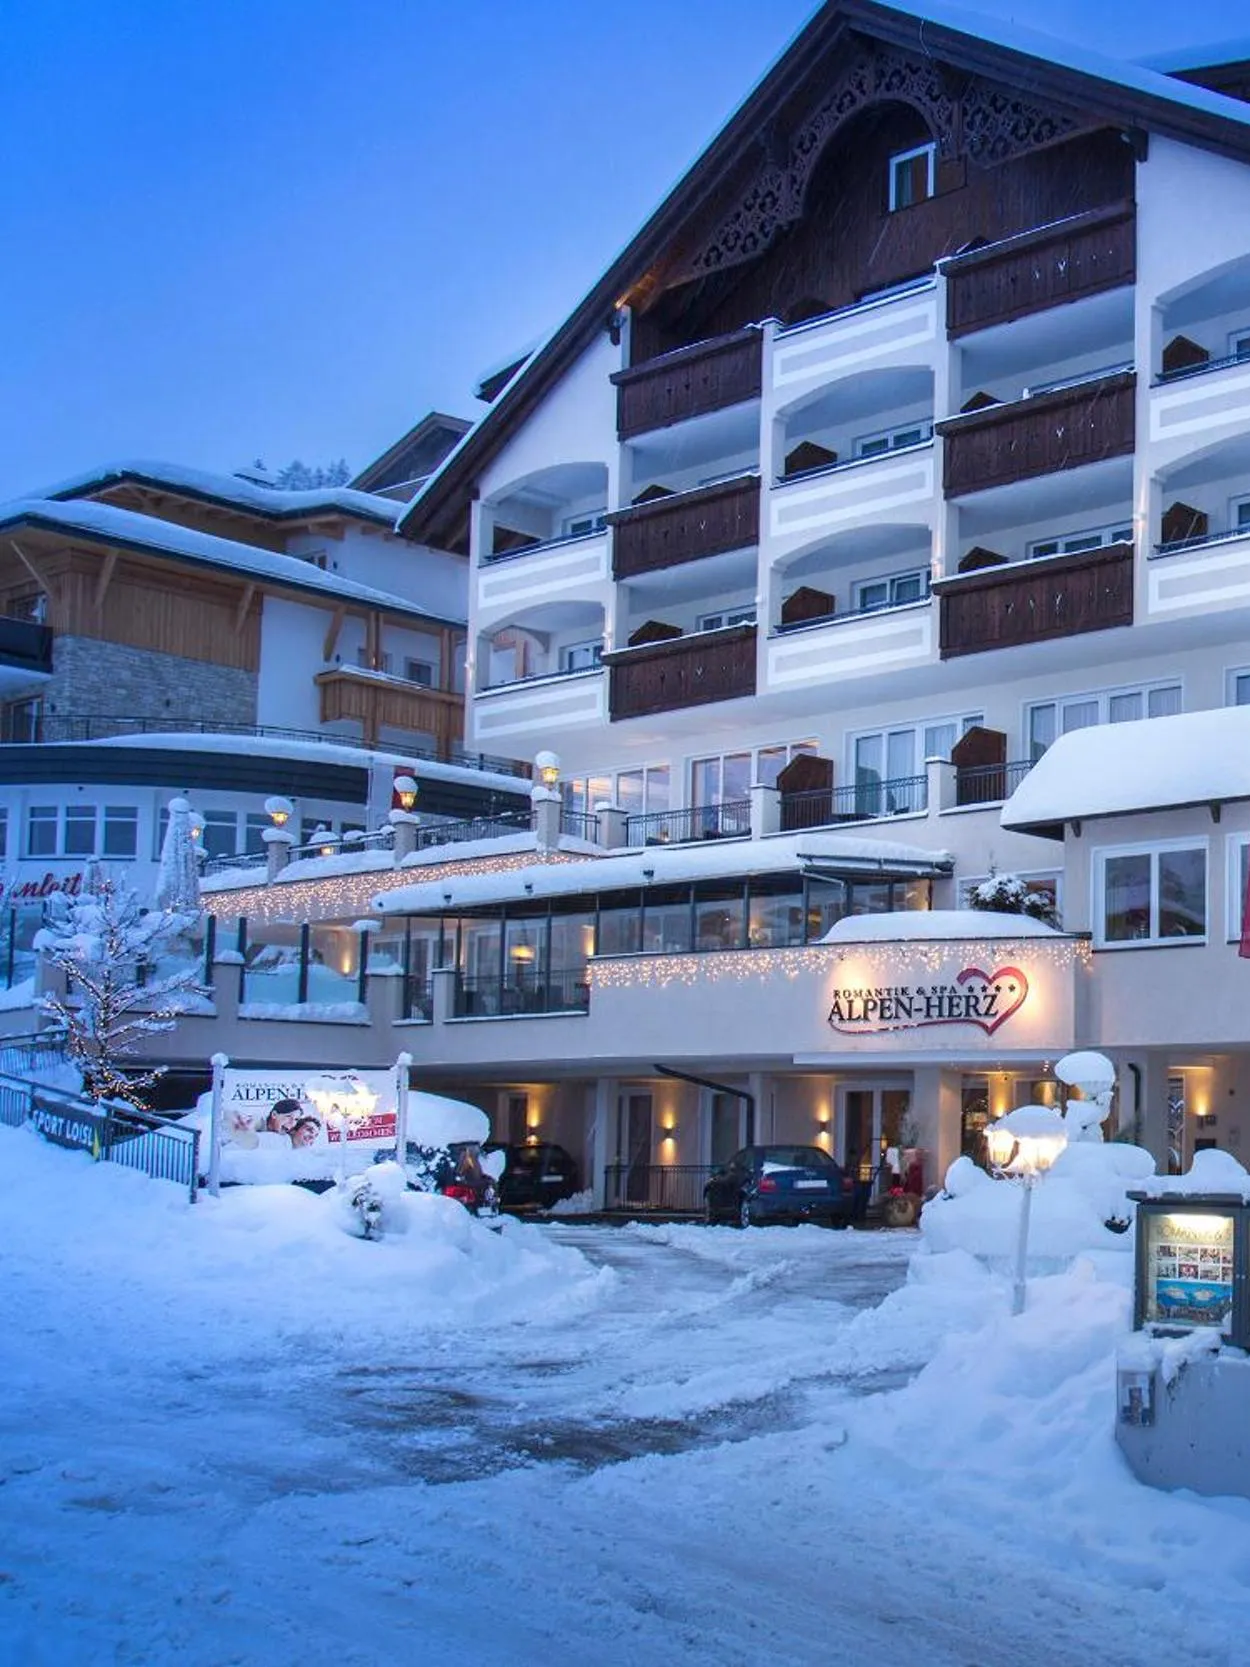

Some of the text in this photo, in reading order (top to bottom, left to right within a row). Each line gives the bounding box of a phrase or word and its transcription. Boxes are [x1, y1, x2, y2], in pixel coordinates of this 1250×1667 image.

[833, 984, 958, 999] ROMANTIK & SPA
[827, 993, 999, 1022] ALPEN-HERZ
[231, 1087, 310, 1101] ALPEN-H
[66, 1119, 94, 1147] LOISL
